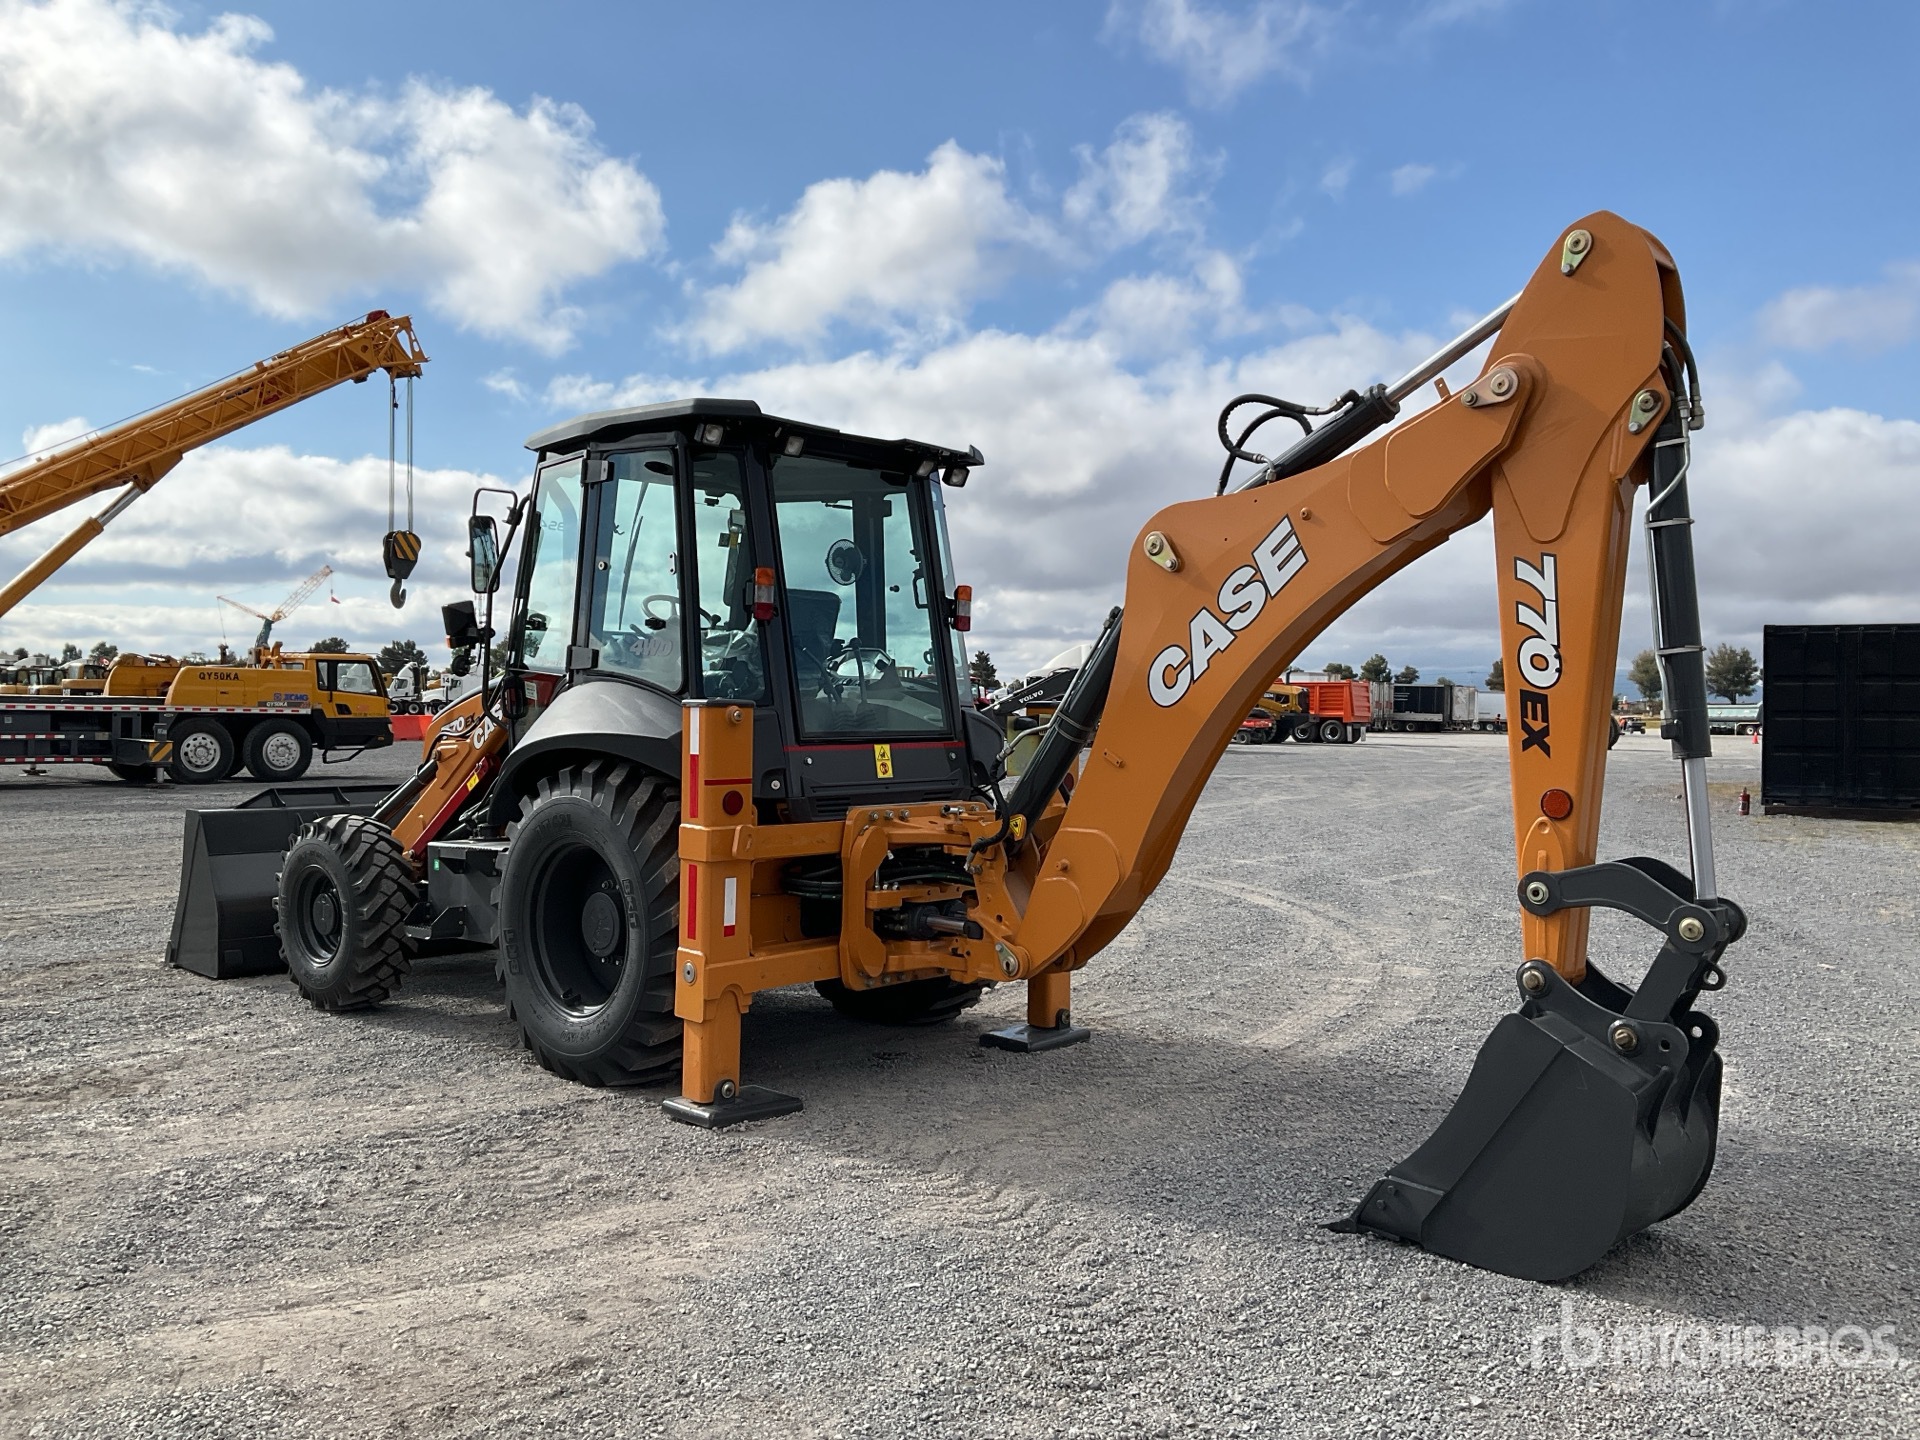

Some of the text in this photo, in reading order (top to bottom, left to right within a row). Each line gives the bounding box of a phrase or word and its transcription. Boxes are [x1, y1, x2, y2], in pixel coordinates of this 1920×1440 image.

[1147, 513, 1309, 708] CASE
[629, 638, 674, 657] 4WD
[1514, 552, 1562, 760] 770 EX
[198, 671, 240, 681] QY50KA
[1018, 689, 1044, 704] VOLVO
